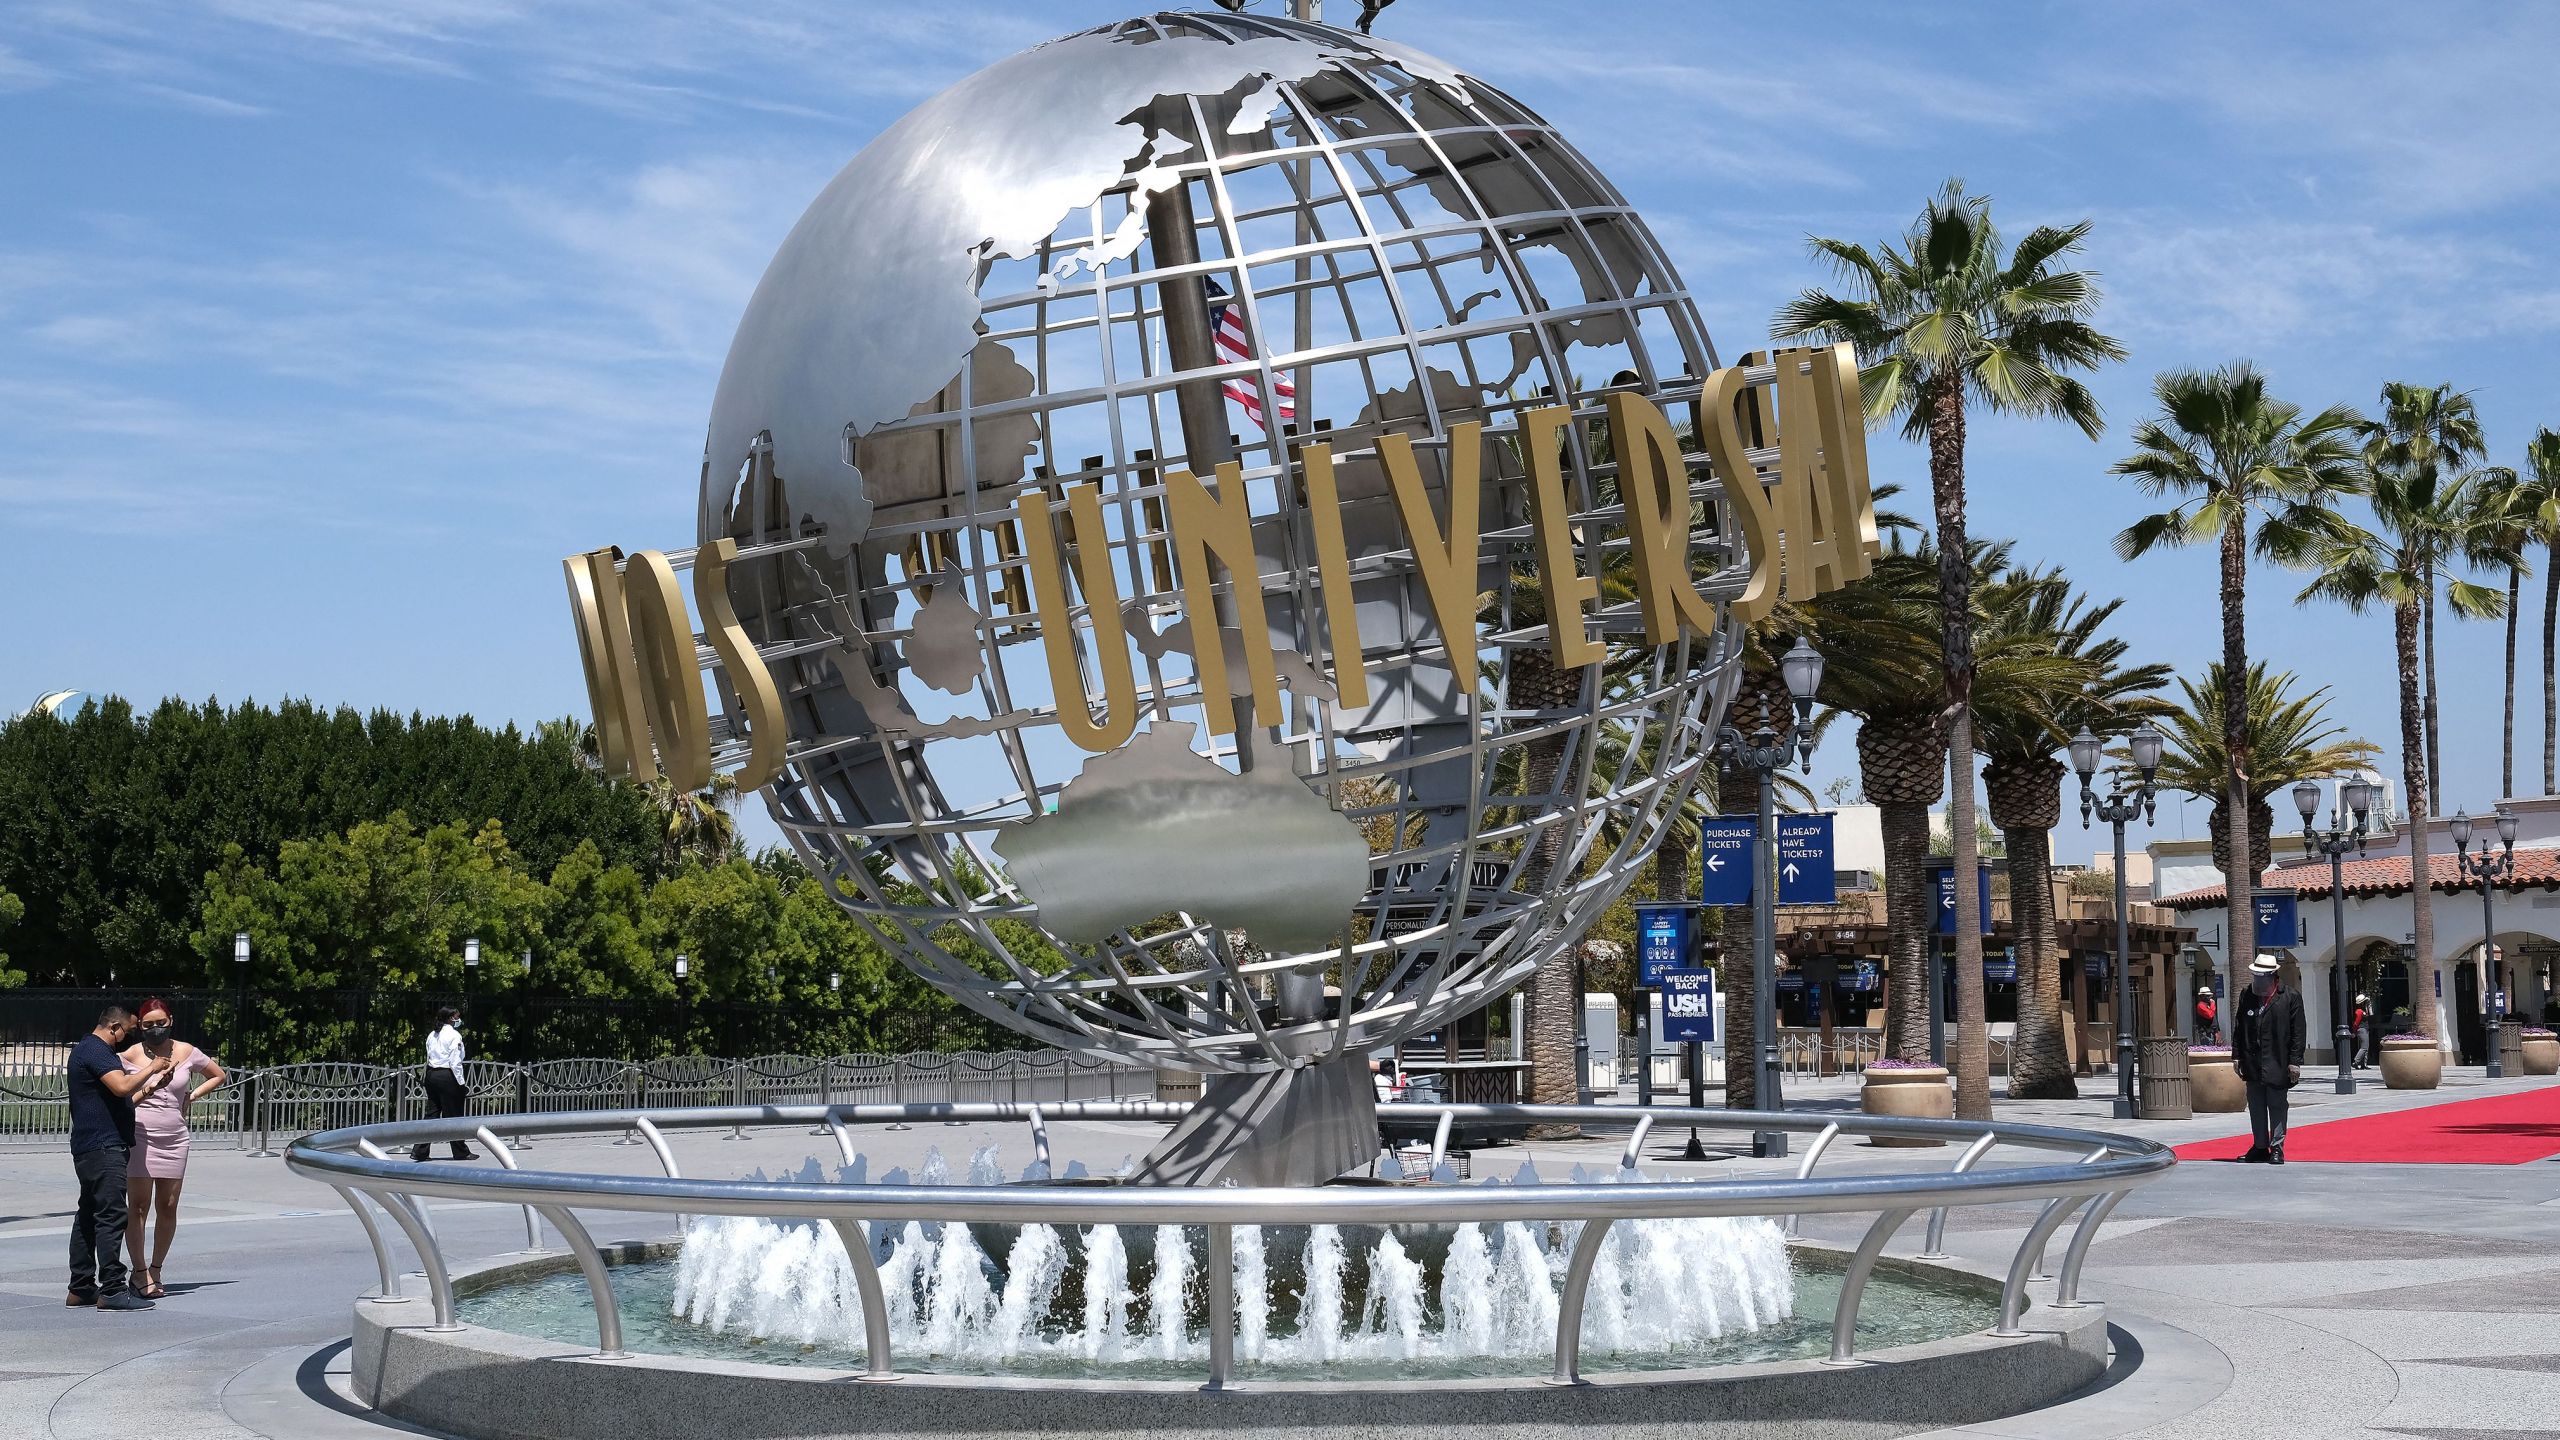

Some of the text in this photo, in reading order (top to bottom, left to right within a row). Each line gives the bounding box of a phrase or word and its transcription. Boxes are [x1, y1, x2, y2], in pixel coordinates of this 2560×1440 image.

[1018, 341, 1881, 752] UNIVERSAL
[1706, 829, 1751, 838] PURCHASE
[1782, 827, 1821, 836] ALREADY
[1706, 841, 1741, 849] TICKETS
[1782, 839, 1805, 847] HAVE
[1782, 849, 1823, 859] TICKETS?
[1472, 863, 1498, 886] VIP
[1386, 920, 1428, 931] PERSONALIZ
[1665, 975, 1709, 983] WELCOME
[1675, 982, 1699, 990] BACK
[1998, 984, 2004, 992] 7
[1668, 994, 1706, 1012] USH
